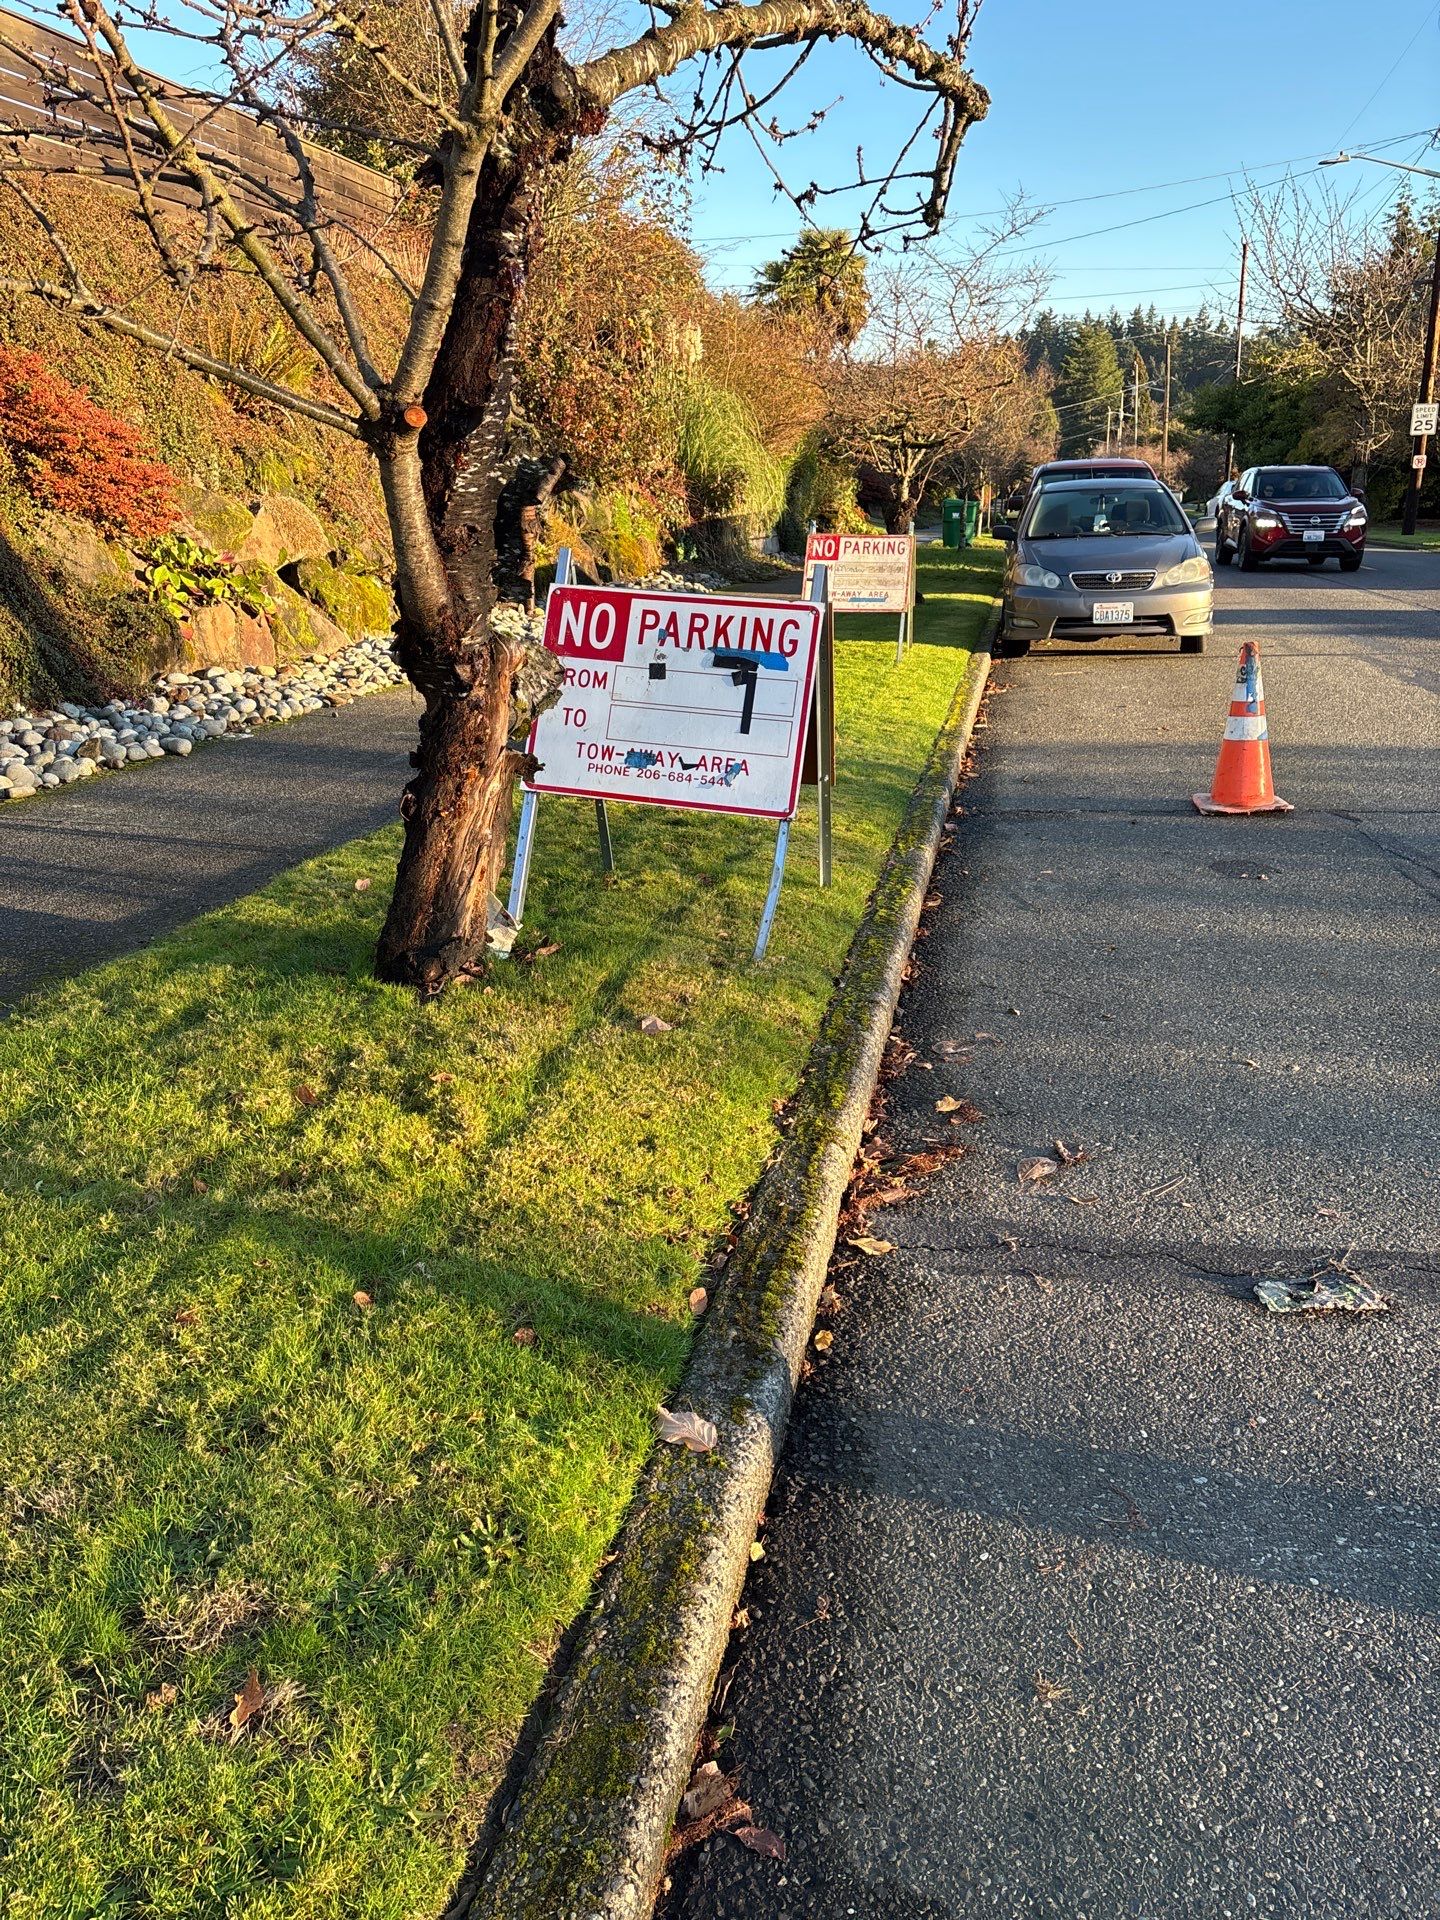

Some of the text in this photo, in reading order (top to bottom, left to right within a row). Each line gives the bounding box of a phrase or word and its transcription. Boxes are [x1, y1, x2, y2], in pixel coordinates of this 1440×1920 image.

[1413, 419, 1433, 431] 25
[812, 539, 906, 557] NO PARKING
[557, 600, 801, 658] NO PARKING
[563, 667, 609, 690] ROM
[562, 707, 587, 728] TO
[587, 762, 732, 787] PHONE 206-684-544
[695, 754, 751, 777] AREA
